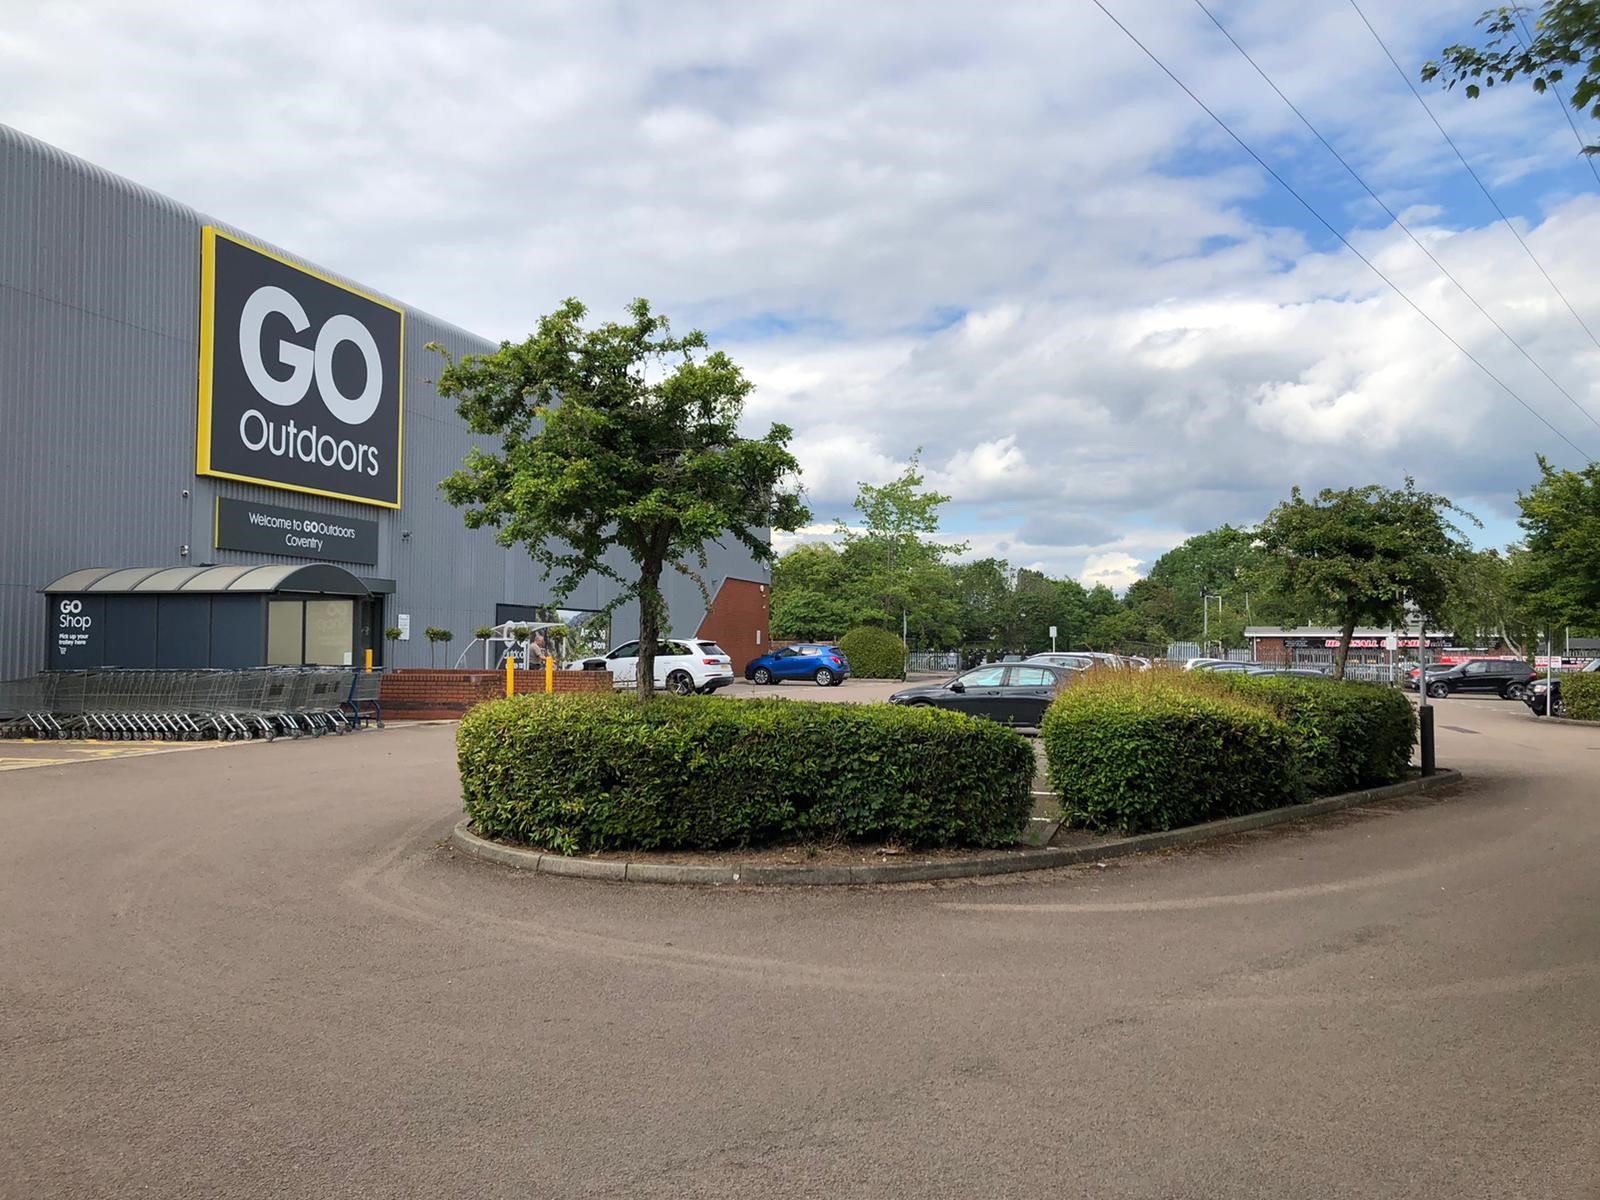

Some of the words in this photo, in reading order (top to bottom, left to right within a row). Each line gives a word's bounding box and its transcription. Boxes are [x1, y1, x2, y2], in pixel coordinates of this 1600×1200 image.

[239, 285, 383, 425] GO
[239, 409, 379, 477] Outdoors
[248, 512, 292, 530] Welcome
[293, 519, 302, 531] to
[285, 534, 323, 552] Coventry
[60, 600, 82, 614] GO
[60, 614, 92, 631] Shop
